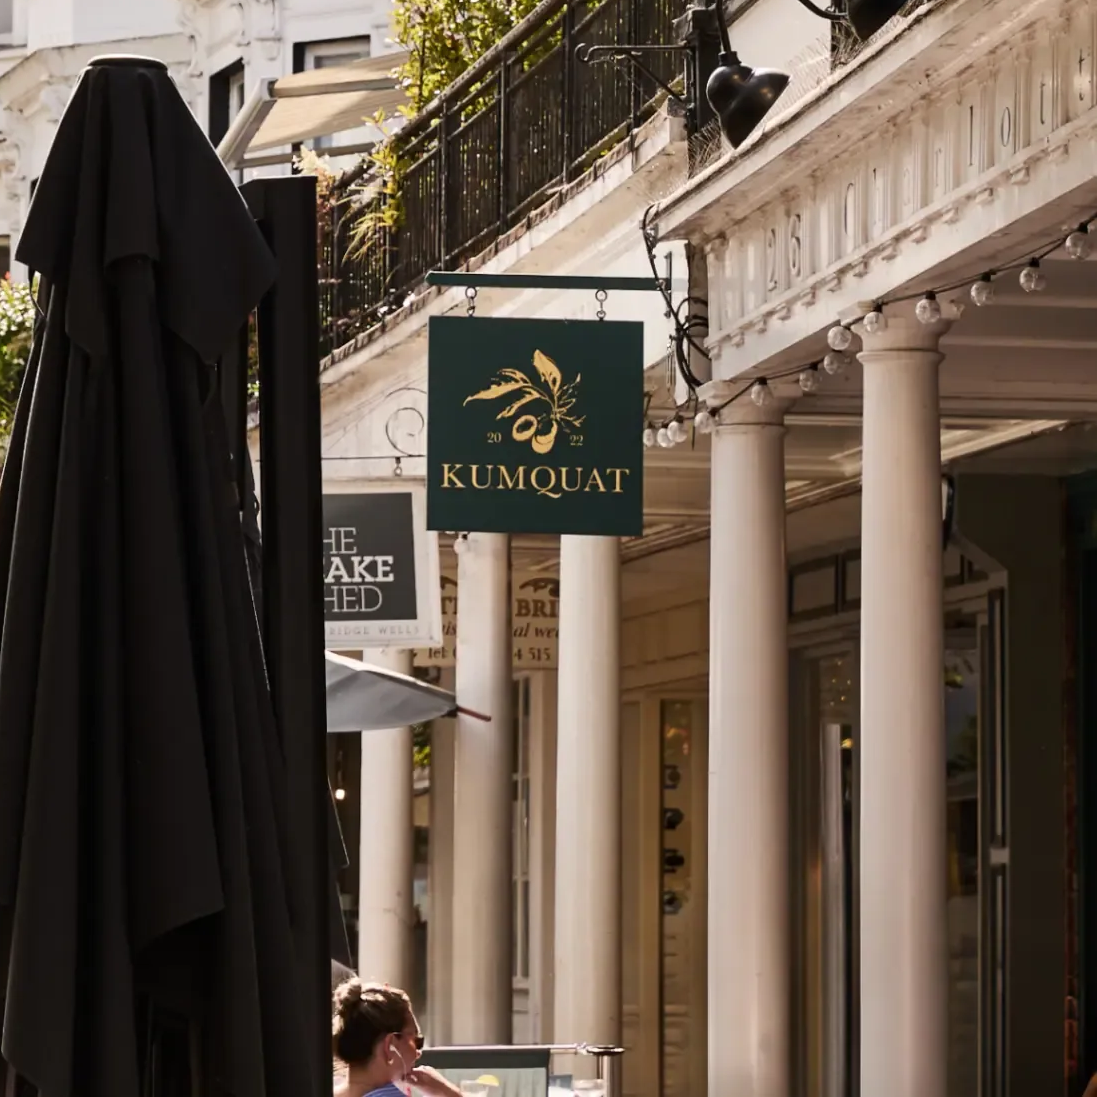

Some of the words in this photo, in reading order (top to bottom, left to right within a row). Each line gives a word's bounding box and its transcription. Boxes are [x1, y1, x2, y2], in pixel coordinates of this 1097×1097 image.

[486, 432, 502, 444] 20
[569, 434, 584, 447] 22
[440, 463, 630, 499] KUMQUAT
[323, 527, 357, 554] HE
[323, 555, 395, 583] AKE
[324, 585, 383, 612] HED
[515, 598, 559, 618] BRI
[329, 626, 369, 636] RIDGE
